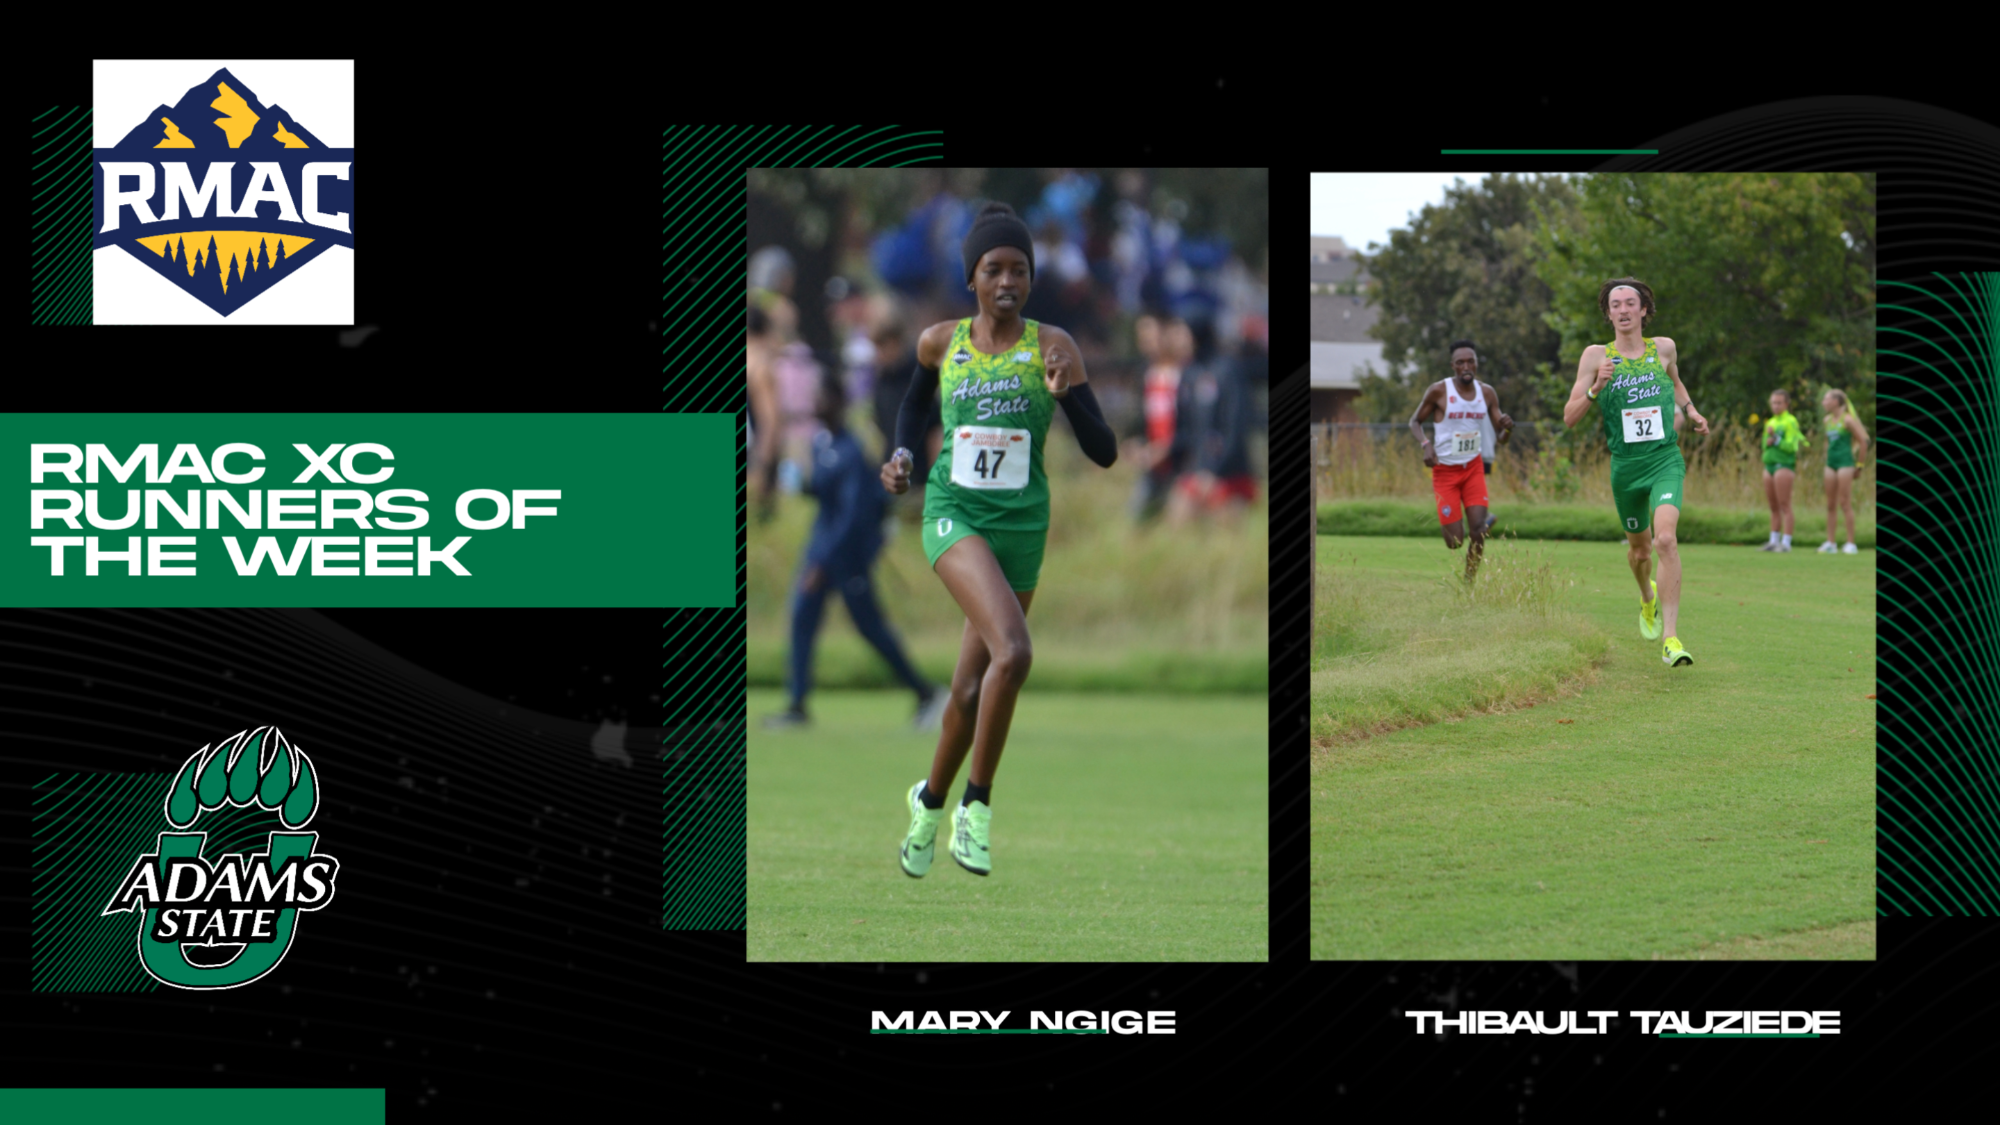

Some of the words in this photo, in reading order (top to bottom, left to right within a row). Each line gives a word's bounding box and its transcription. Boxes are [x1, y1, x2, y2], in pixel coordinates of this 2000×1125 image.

[951, 374, 1022, 405] Adams
[1610, 371, 1656, 393] Adams
[1626, 384, 1661, 404] State
[976, 395, 1030, 421] State
[974, 432, 1007, 441] COWBOY
[1635, 418, 1653, 437] 32
[1457, 439, 1475, 452] 181
[974, 448, 1007, 479] 47
